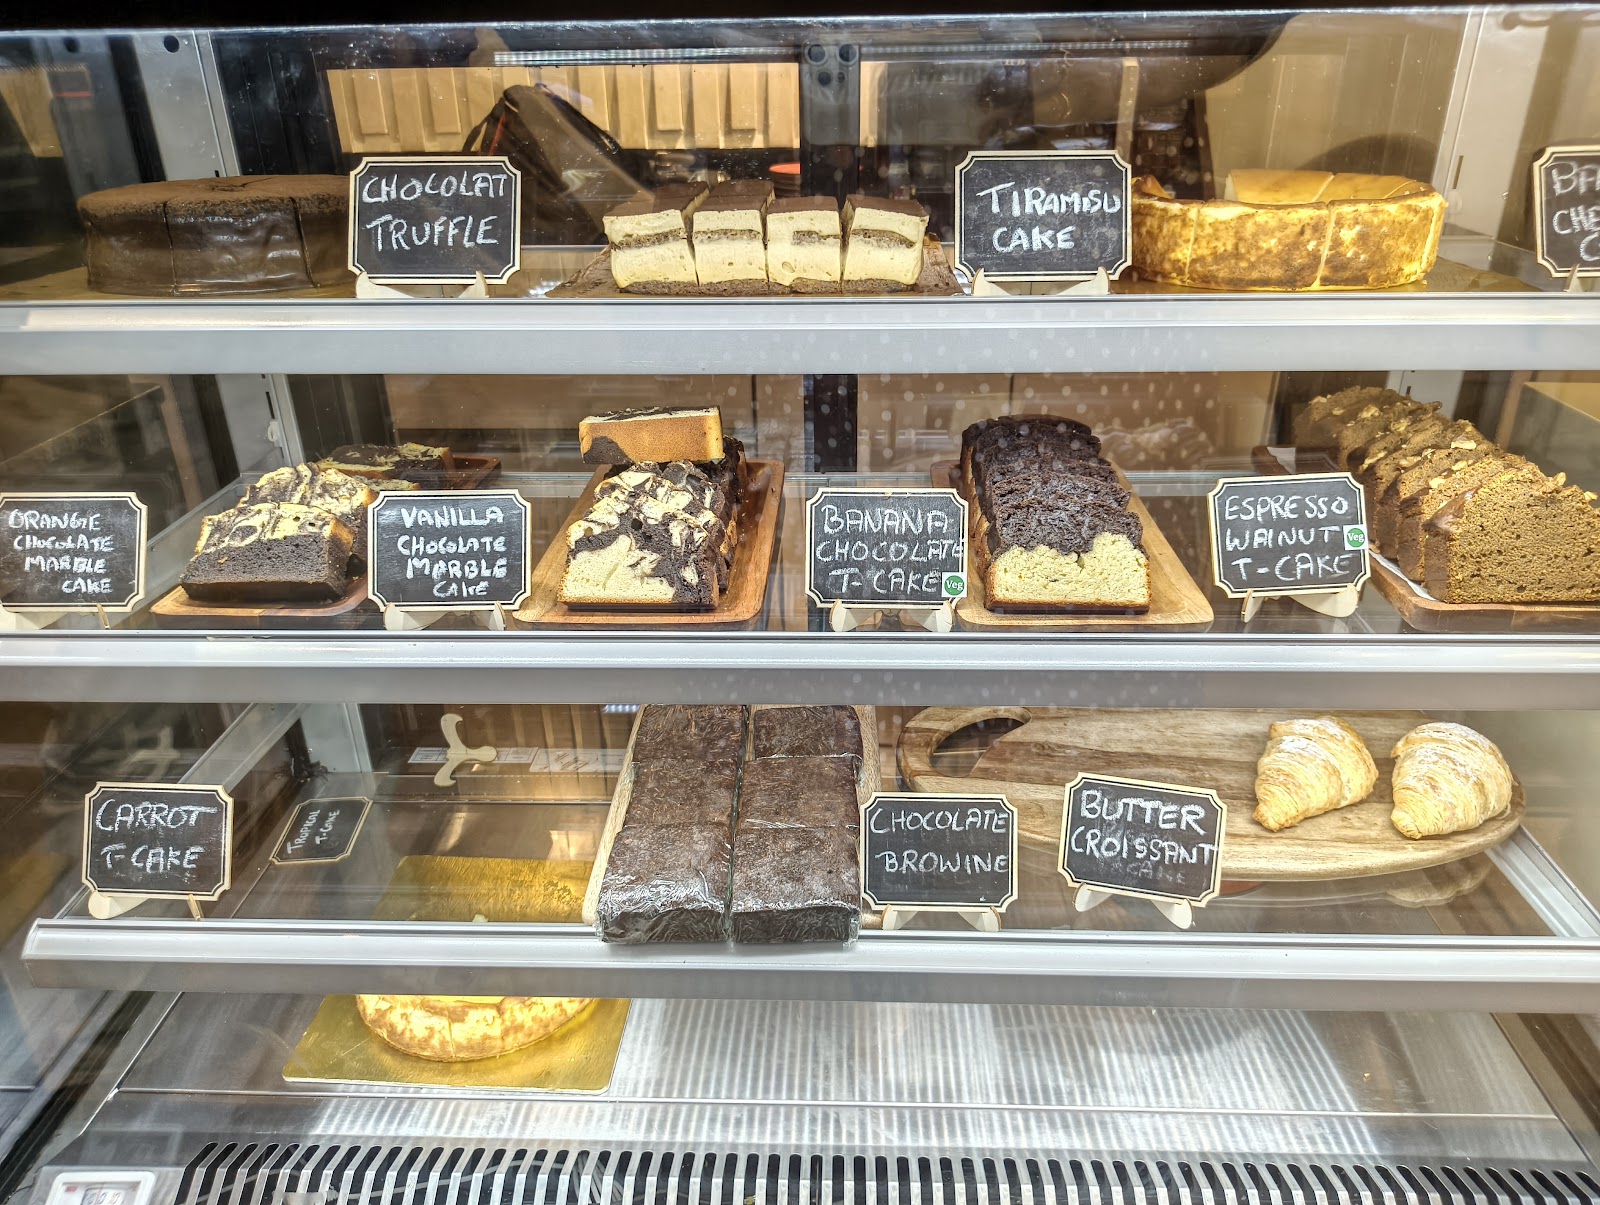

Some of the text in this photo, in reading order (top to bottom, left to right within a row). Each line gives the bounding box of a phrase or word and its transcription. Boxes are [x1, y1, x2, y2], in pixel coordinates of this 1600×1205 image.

[362, 171, 507, 203] CHOCOLAT
[976, 181, 1122, 217] TIRAMISU
[366, 214, 499, 251] TRUFFLE
[992, 226, 1076, 253] CAKE
[9, 509, 101, 531] ORANGE
[400, 505, 504, 528] VANILLA
[821, 504, 948, 535] BANANA
[1224, 494, 1349, 524] ESPRESSO
[13, 534, 115, 553] CHOCOLATE
[396, 534, 507, 556] CHOCOLATE
[1347, 532, 1365, 543] Veg
[815, 539, 964, 562] CHOCOLATE
[24, 555, 107, 573] MARBLE
[406, 556, 508, 580] MARBLE
[61, 577, 114, 594] CAKE
[432, 580, 489, 598] CAKE
[945, 582, 964, 594] Veg
[95, 799, 218, 832] CARROT
[870, 808, 1008, 833] CHOCOLATE
[1080, 789, 1207, 835] BUTTER
[1071, 826, 1219, 865] CROISSANT
